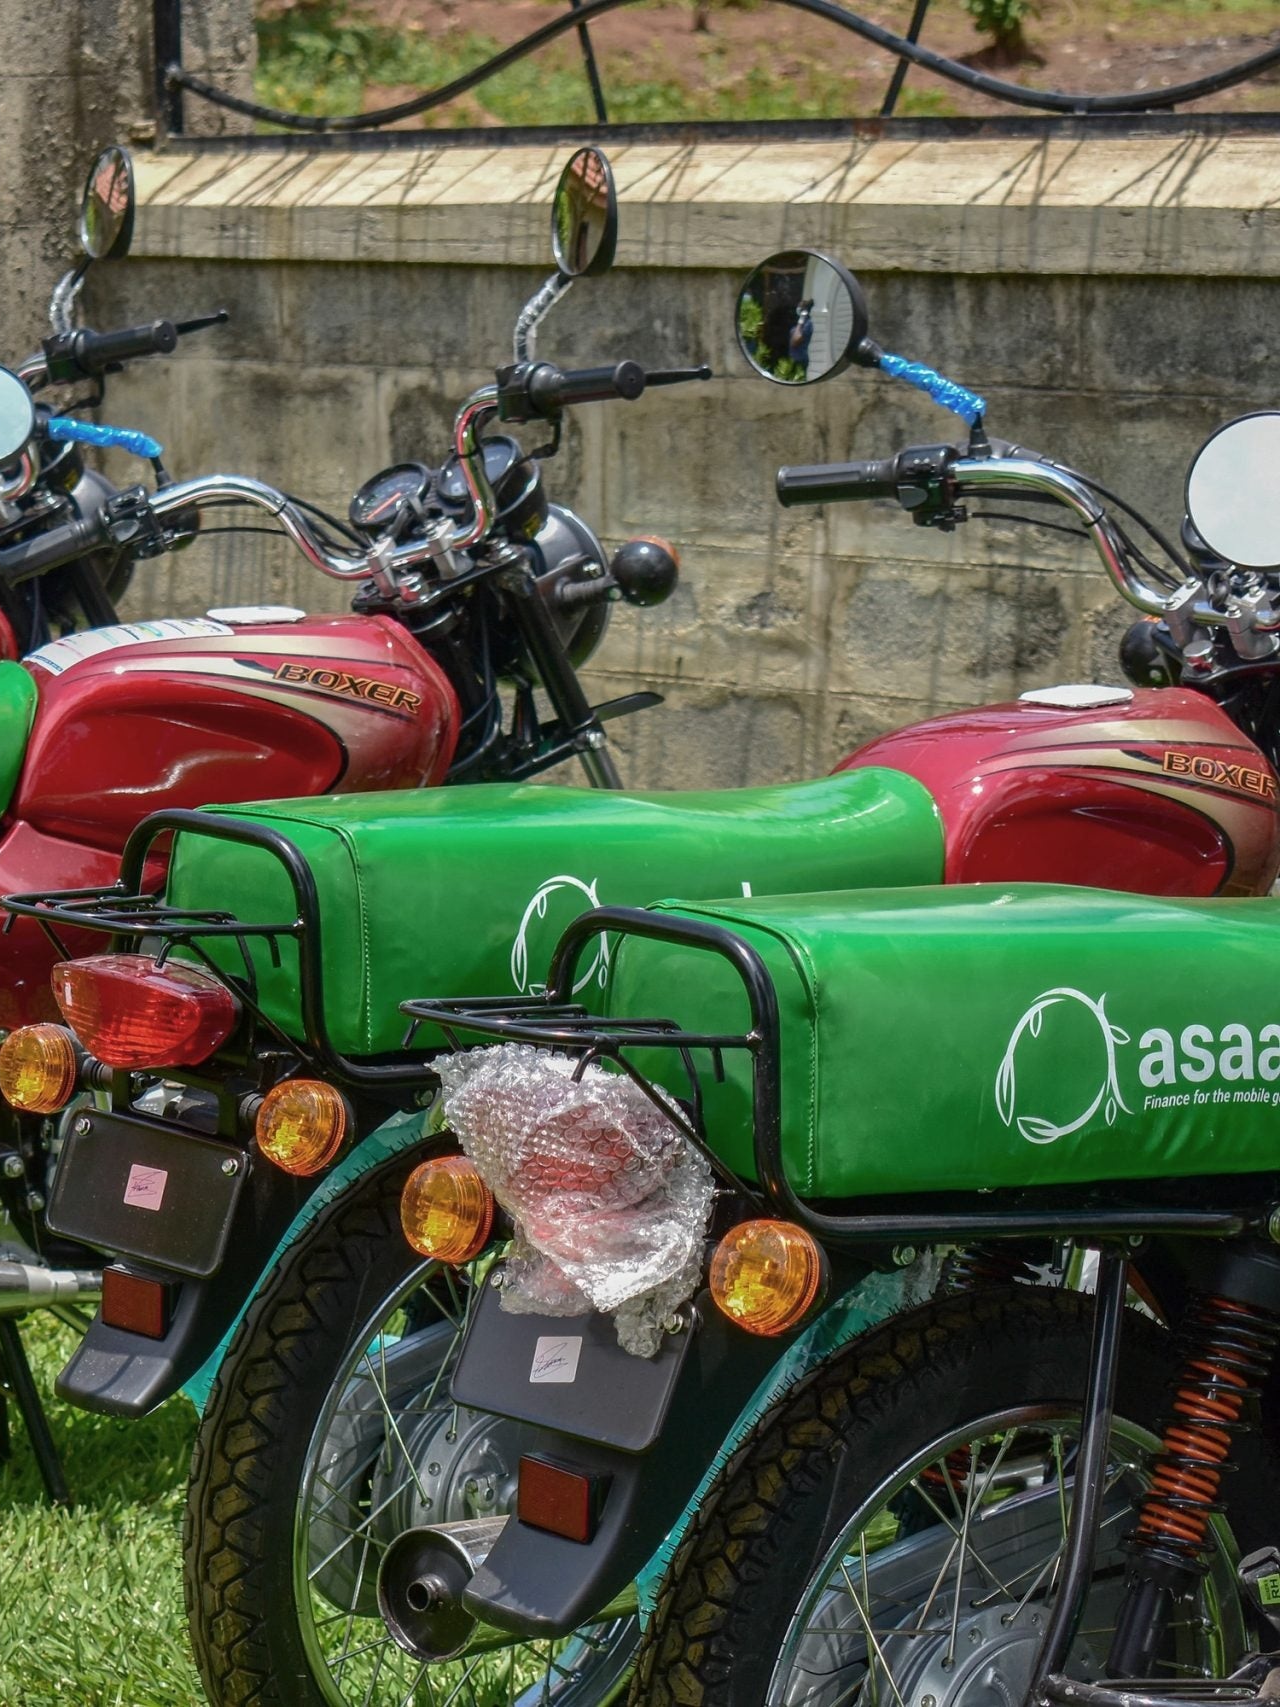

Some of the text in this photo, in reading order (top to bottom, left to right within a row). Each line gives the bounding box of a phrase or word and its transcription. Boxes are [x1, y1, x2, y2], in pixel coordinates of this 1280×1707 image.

[273, 662, 422, 714] BOXER
[1162, 751, 1277, 799] BOXER
[1138, 1023, 1280, 1088] asaa
[1144, 1094, 1190, 1111] Finance
[1193, 1089, 1211, 1104] for
[1213, 1088, 1231, 1103] the
[1233, 1087, 1270, 1103] mobile
